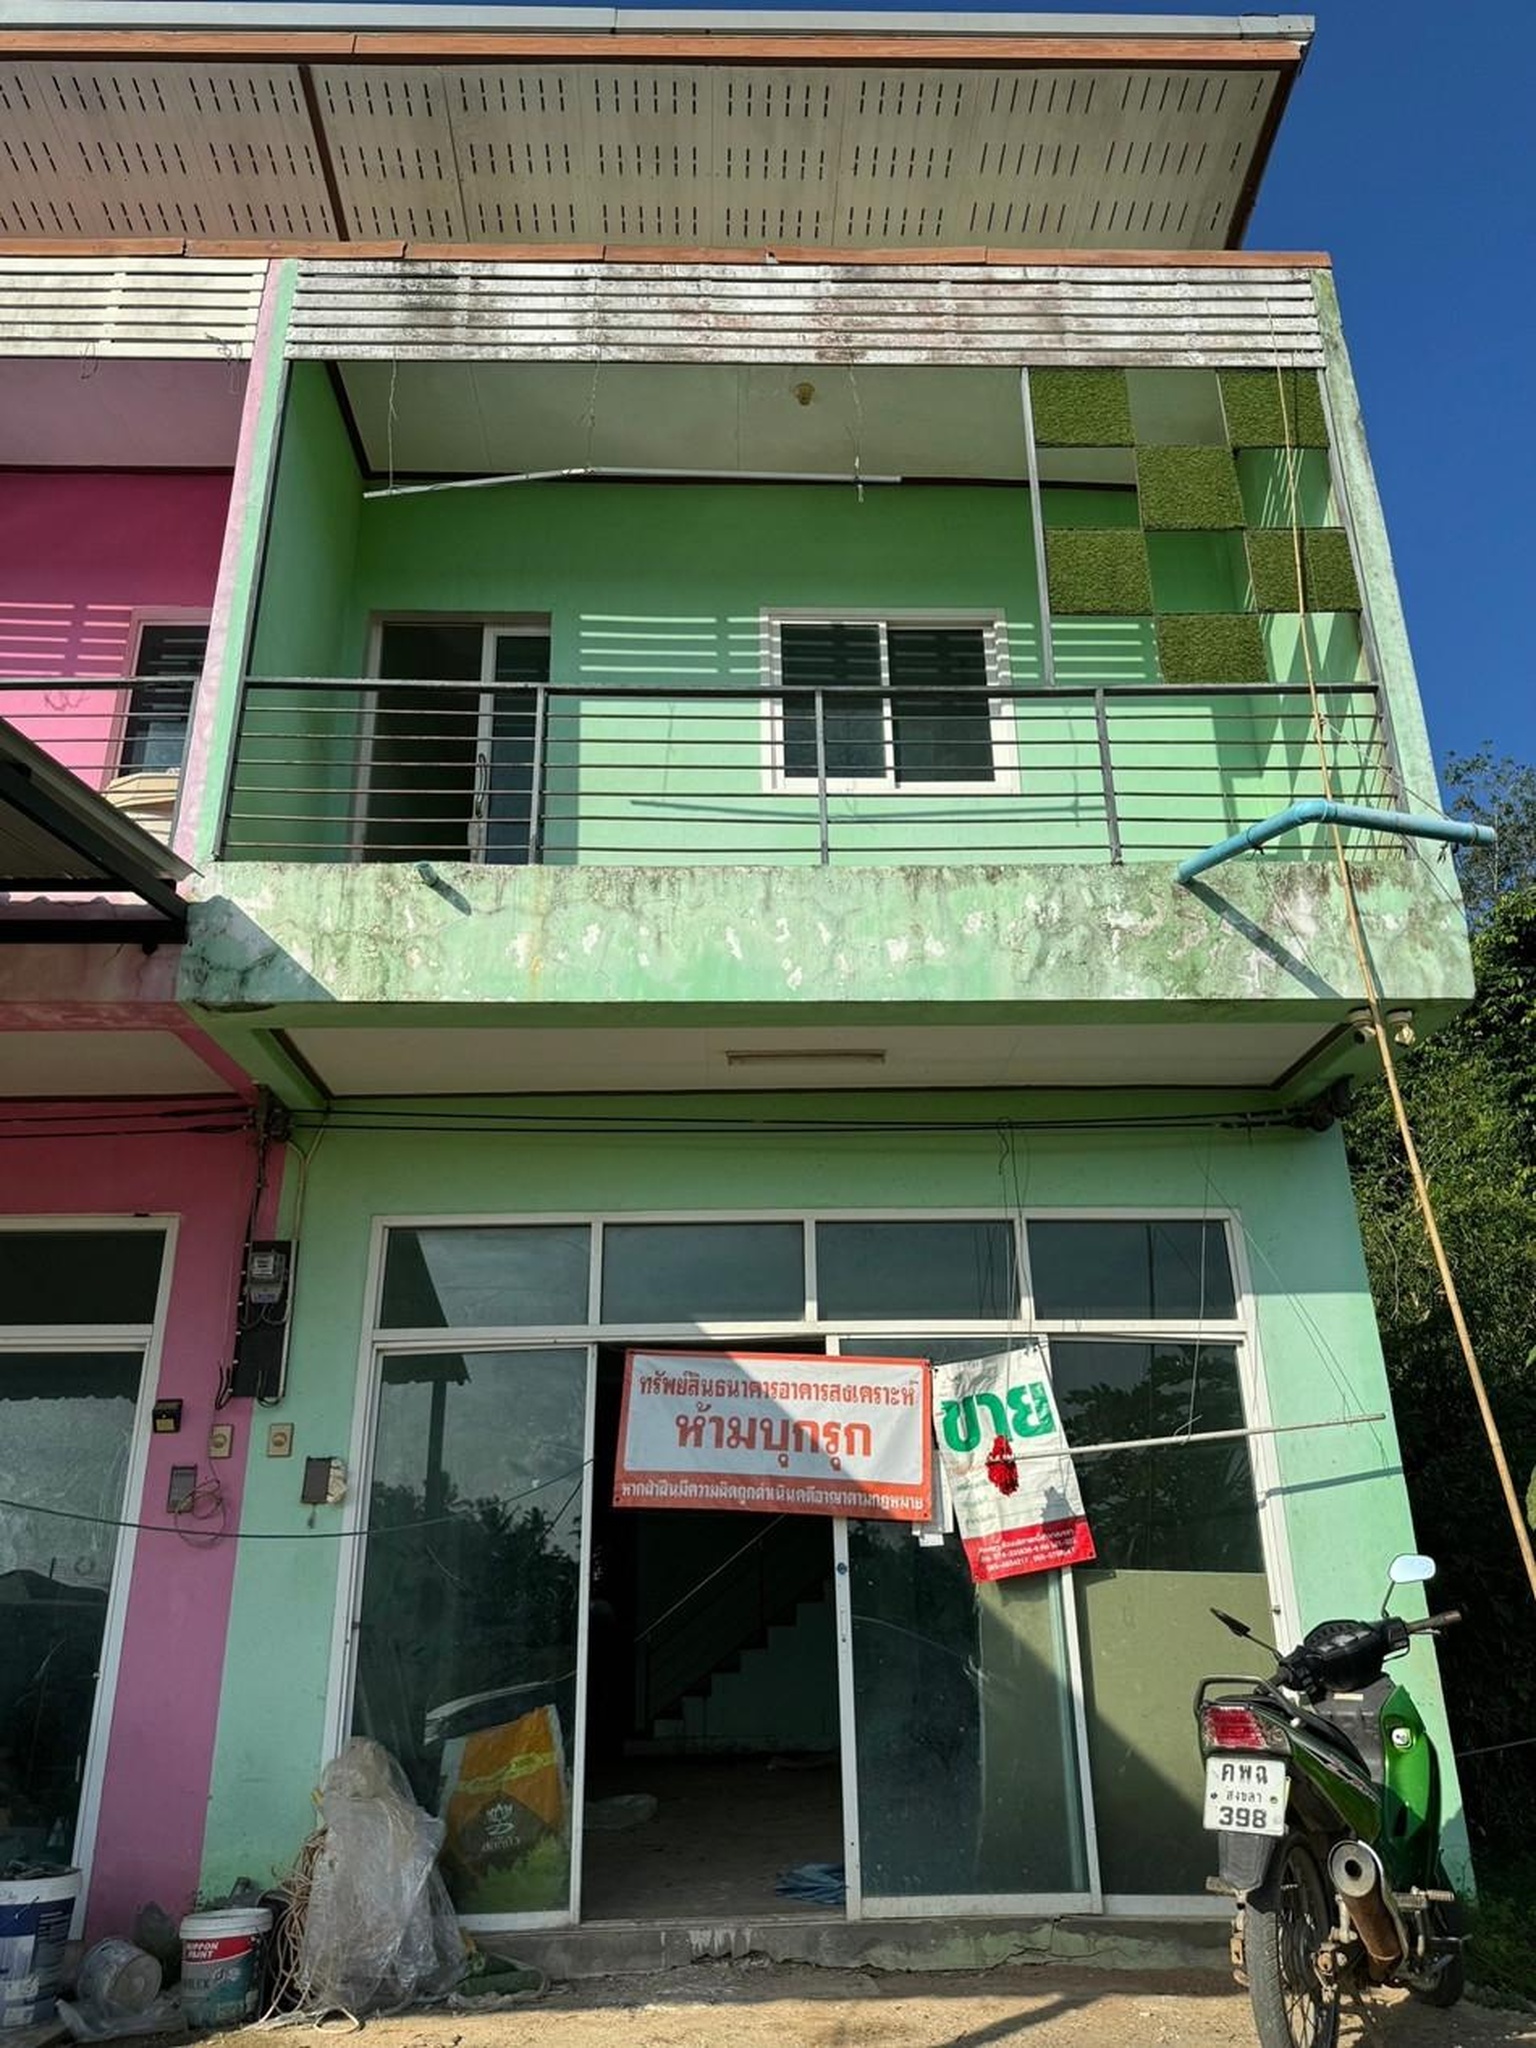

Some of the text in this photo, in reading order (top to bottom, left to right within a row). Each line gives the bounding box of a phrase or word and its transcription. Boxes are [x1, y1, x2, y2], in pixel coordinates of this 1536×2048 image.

[674, 1401, 872, 1471] ห้ามบุกรุก
[941, 1381, 1057, 1453] ขาย
[1219, 1805, 1268, 1829] 398
[1226, 1789, 1263, 1804] สงขลา
